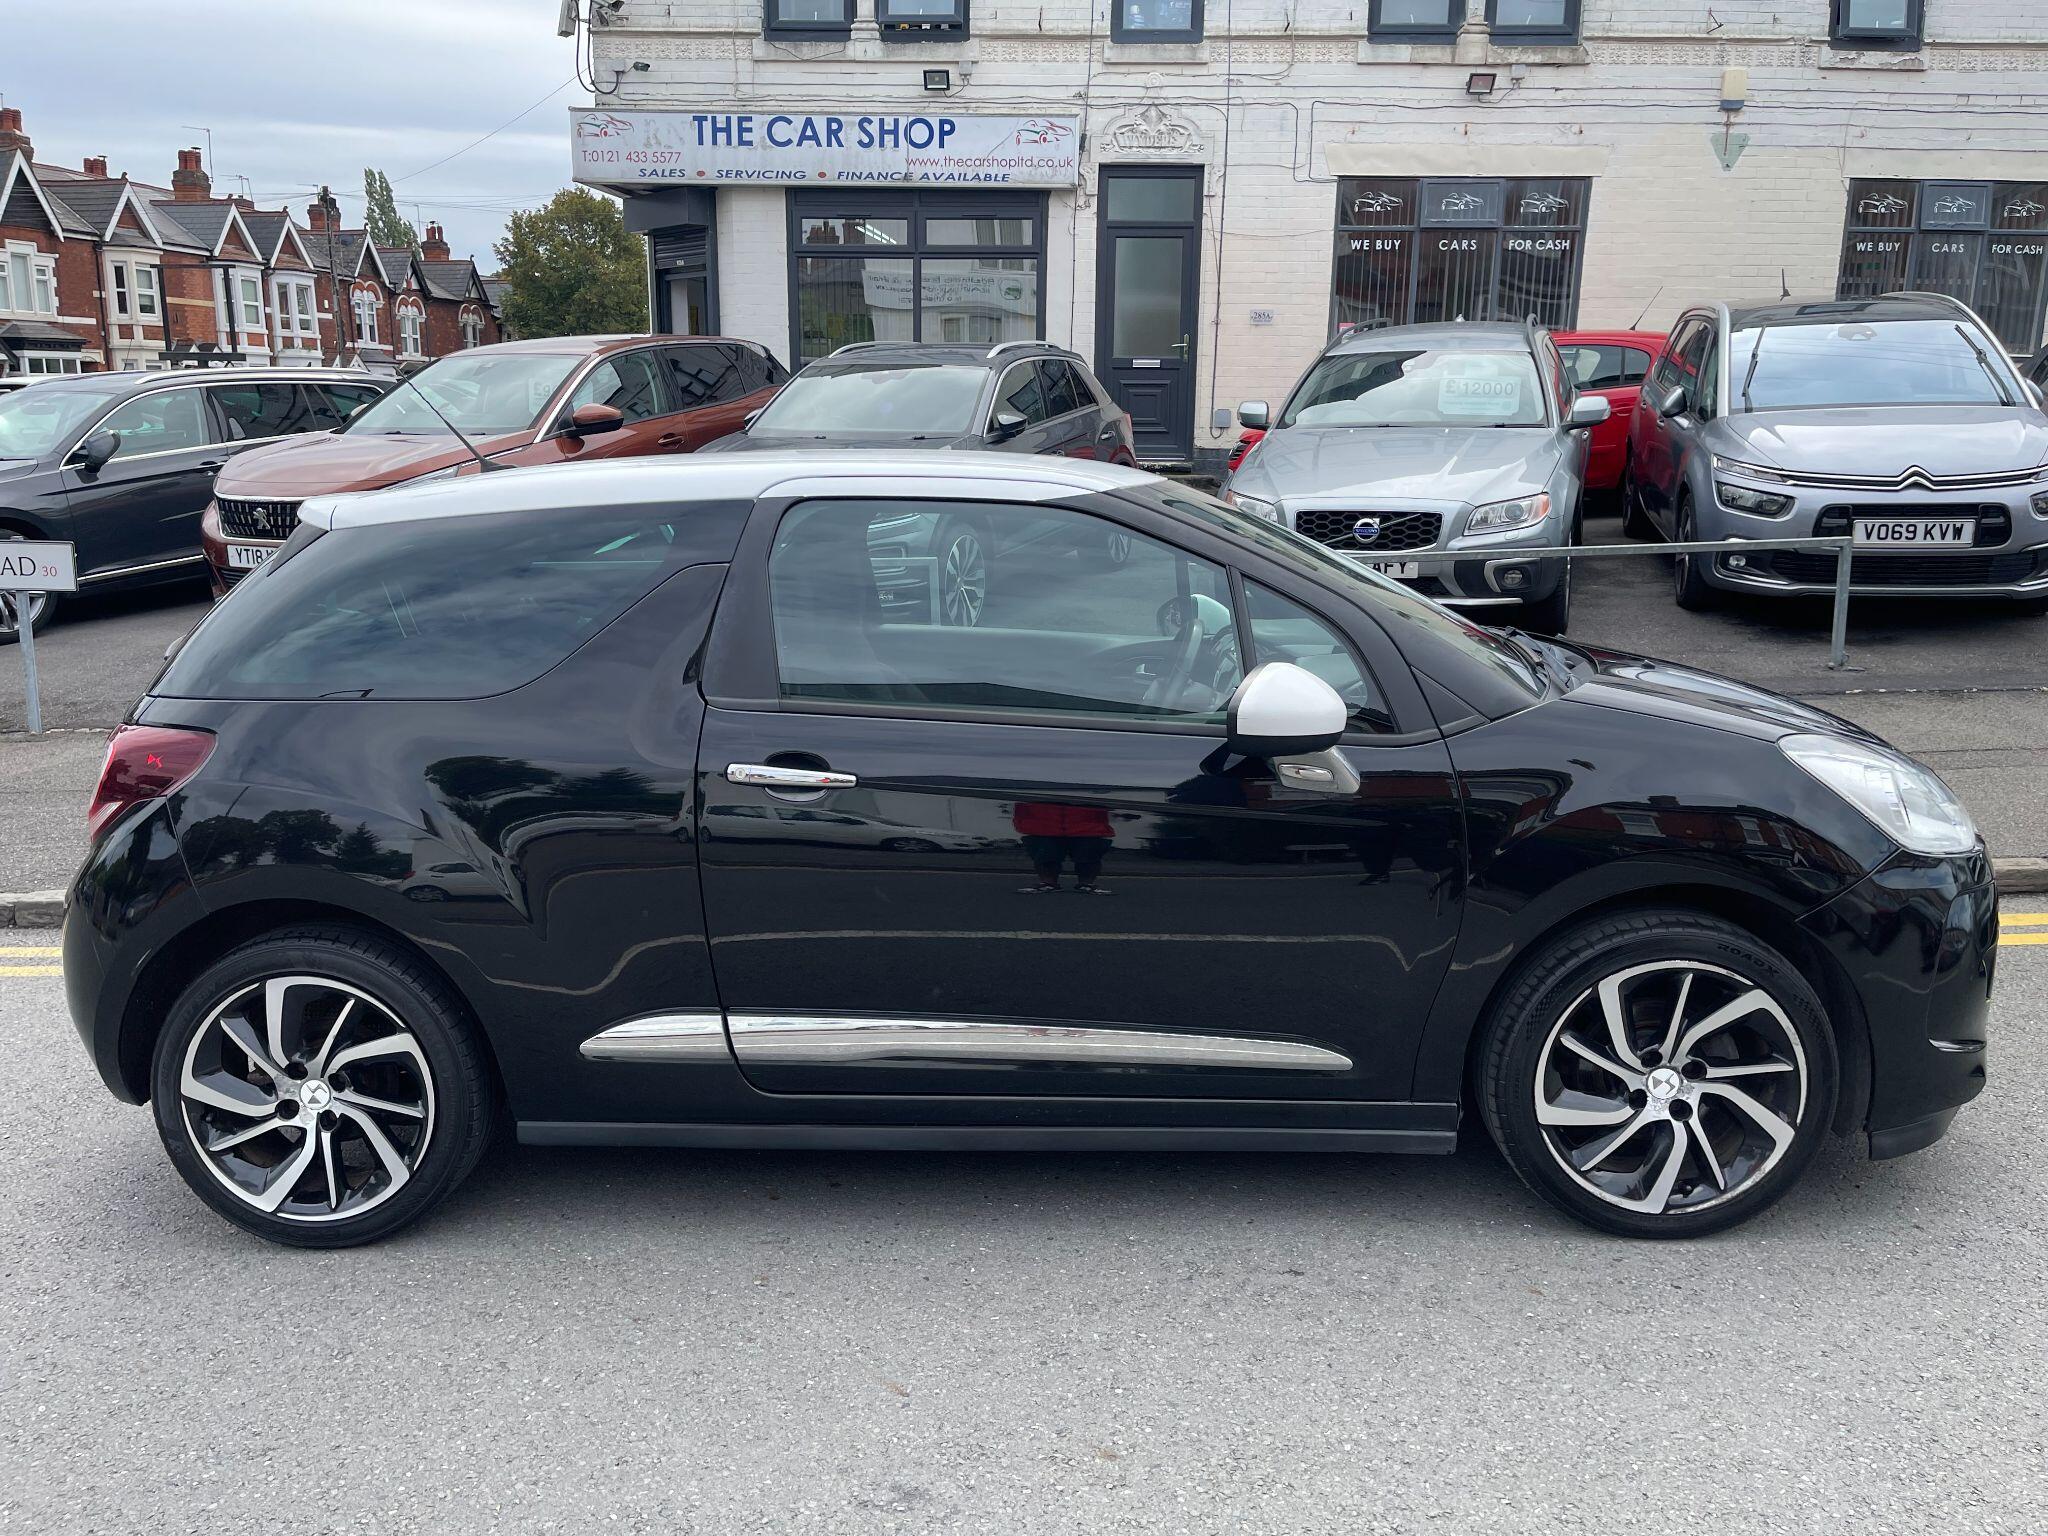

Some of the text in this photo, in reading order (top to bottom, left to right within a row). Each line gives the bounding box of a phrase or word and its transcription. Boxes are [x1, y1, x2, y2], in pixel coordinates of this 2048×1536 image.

[692, 115, 956, 149] THE CAR SHOP
[581, 150, 682, 164] T:0121 433 5577
[905, 155, 1073, 170] www.thecarshopltd.co.uk
[638, 168, 1011, 182] SALES SERVICING FINANCE AVAILABLE
[1350, 239, 1570, 250] WE BUY CARS FOR CASH
[1856, 242, 2044, 255] WE BUY CARS FOR CASH
[1863, 523, 1965, 541] VO69 KVW
[42, 566, 58, 577] 30
[1372, 561, 1408, 575] AFY
[1717, 943, 1780, 977] ROADX
